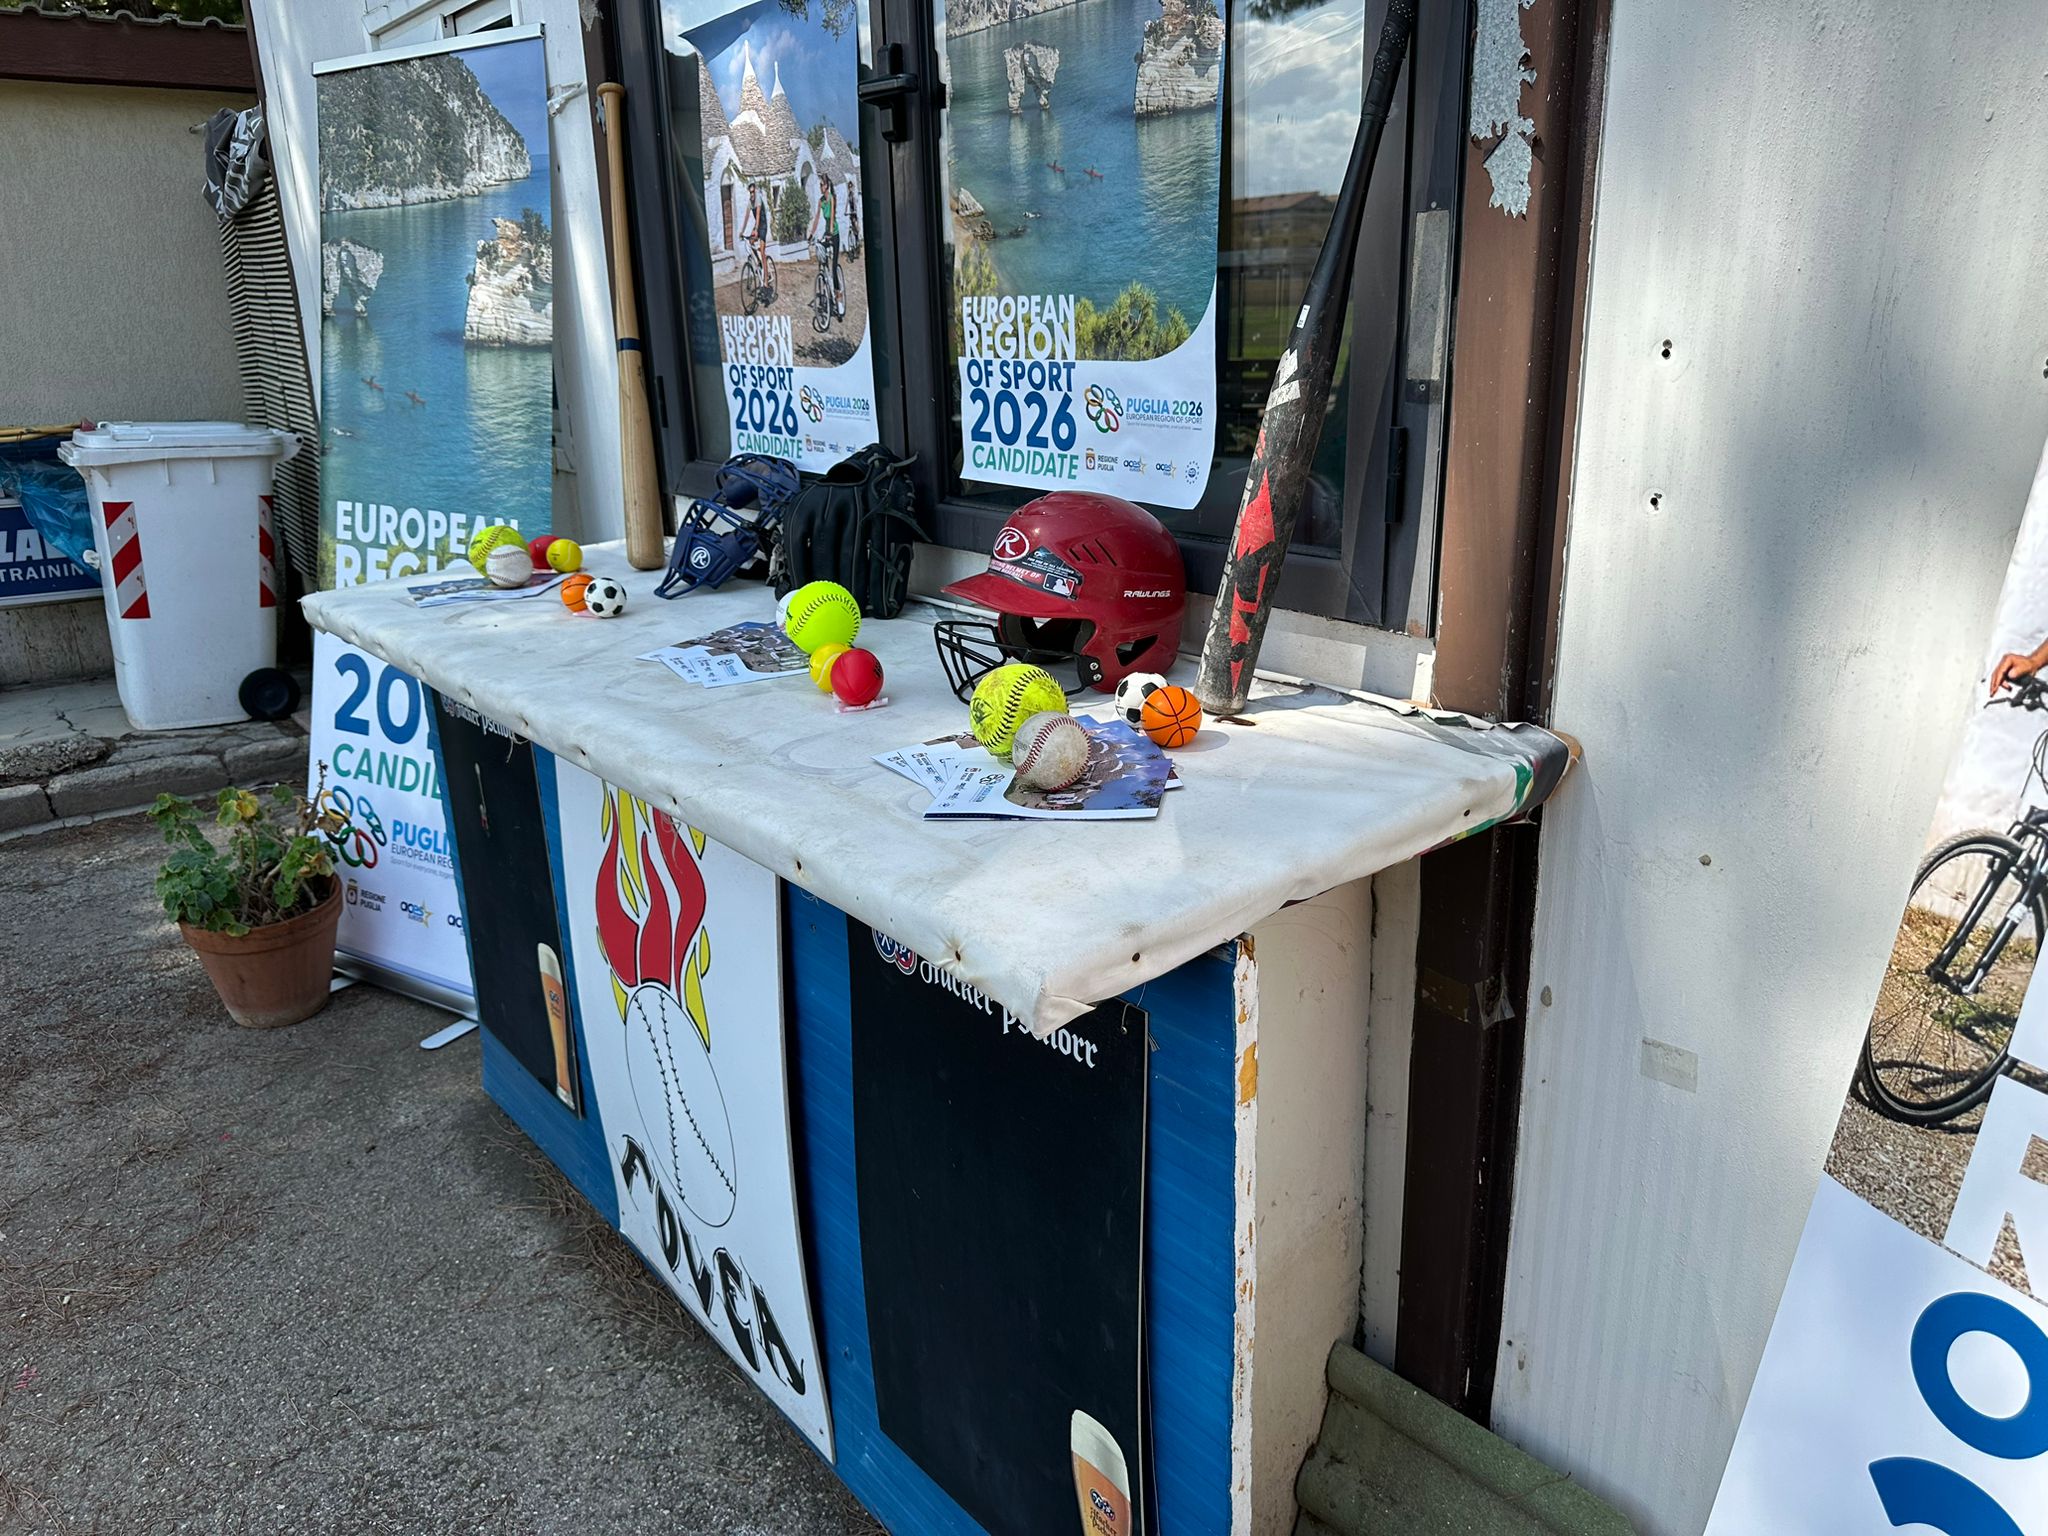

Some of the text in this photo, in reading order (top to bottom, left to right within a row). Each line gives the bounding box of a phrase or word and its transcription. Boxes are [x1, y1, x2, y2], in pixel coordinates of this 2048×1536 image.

[963, 294, 1075, 325] EUROPEAN
[721, 315, 791, 338] EUROPEAN
[725, 335, 794, 367] REGION
[964, 322, 1077, 361] REGION
[729, 364, 794, 392] OF SPORT
[966, 359, 1076, 392] OF SPORT
[732, 387, 799, 438] 2026
[825, 396, 870, 411] PUGLIA 2026
[1126, 397, 1203, 416] PUGLIA 2026
[969, 387, 1077, 452] 2026
[1126, 413, 1203, 424] EUROPEAN REGION OF SPORT
[737, 433, 802, 459] CANDIDATE
[1097, 454, 1118, 464] REGIONE
[972, 444, 1079, 480] CANDIDATE
[1097, 463, 1115, 472] PUGLIA
[1123, 589, 1172, 599] RAWLINGS
[391, 819, 451, 857] PUGLI
[391, 842, 436, 864] EUROPEAN
